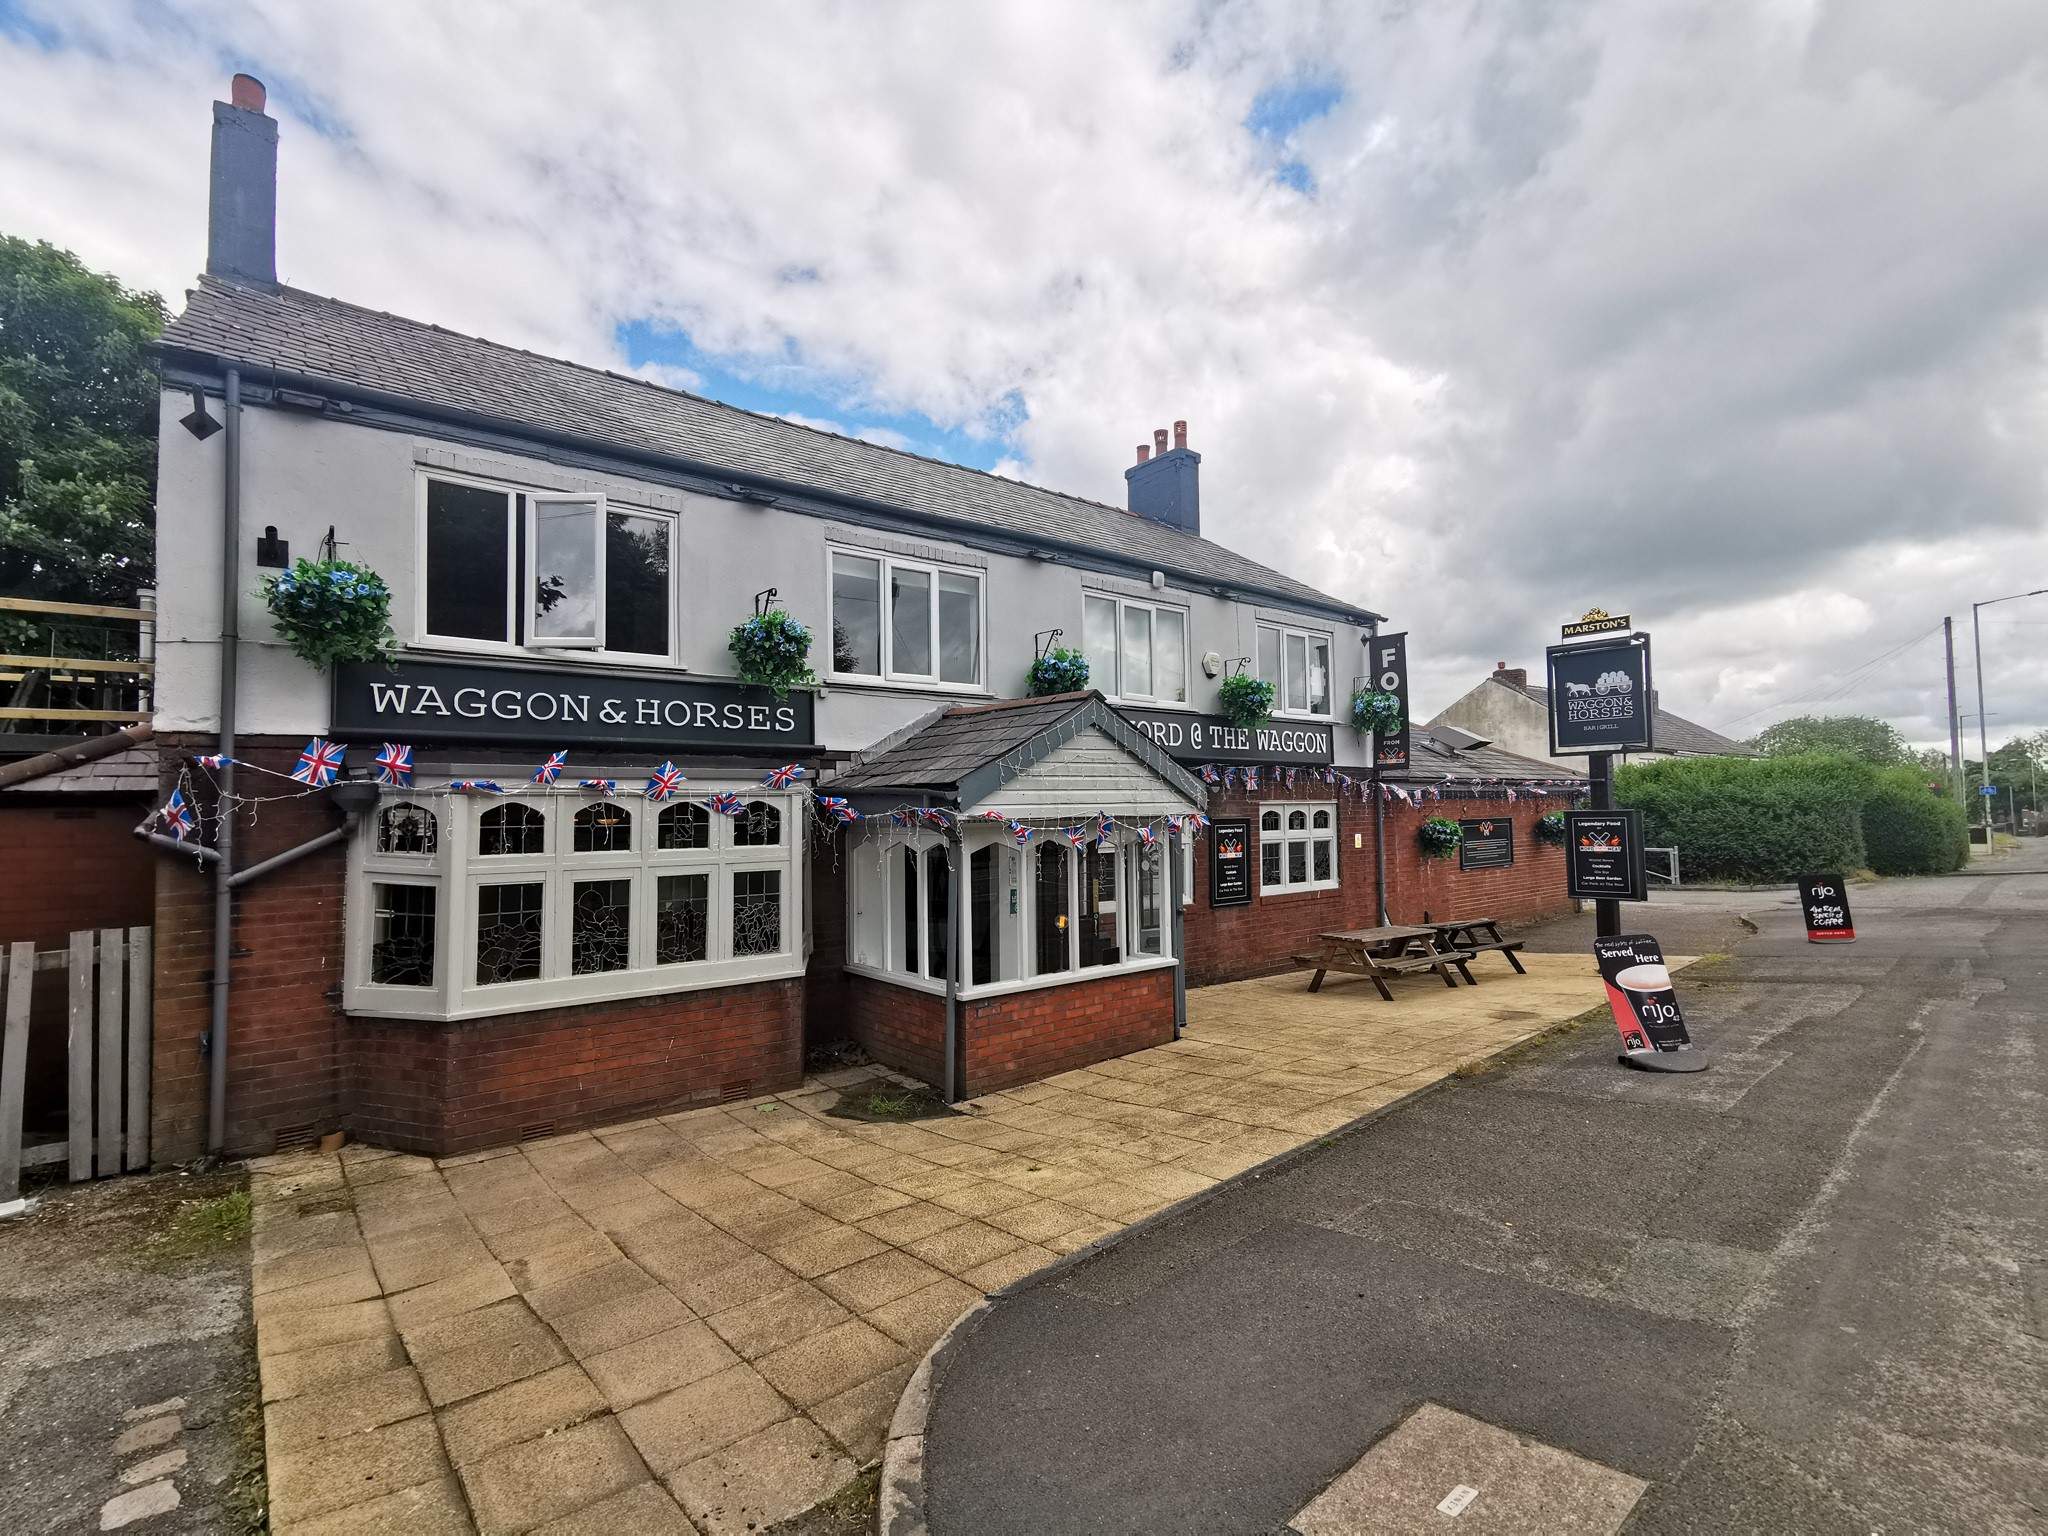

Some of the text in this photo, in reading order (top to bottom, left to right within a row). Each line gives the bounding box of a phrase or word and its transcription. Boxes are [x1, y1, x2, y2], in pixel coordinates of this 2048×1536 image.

[1564, 618, 1626, 635] MARSTON'S
[370, 682, 795, 732] WAGGON & HORSES
[1568, 706, 1634, 720] HORSES
[1130, 720, 1328, 754] ORD @ THE WAGGON
[1812, 886, 1834, 899] rijo
[1601, 946, 1633, 958] Served
[1635, 954, 1659, 963] Here
[1642, 1003, 1674, 1024] rijo
[1626, 1038, 1641, 1048] rijo
